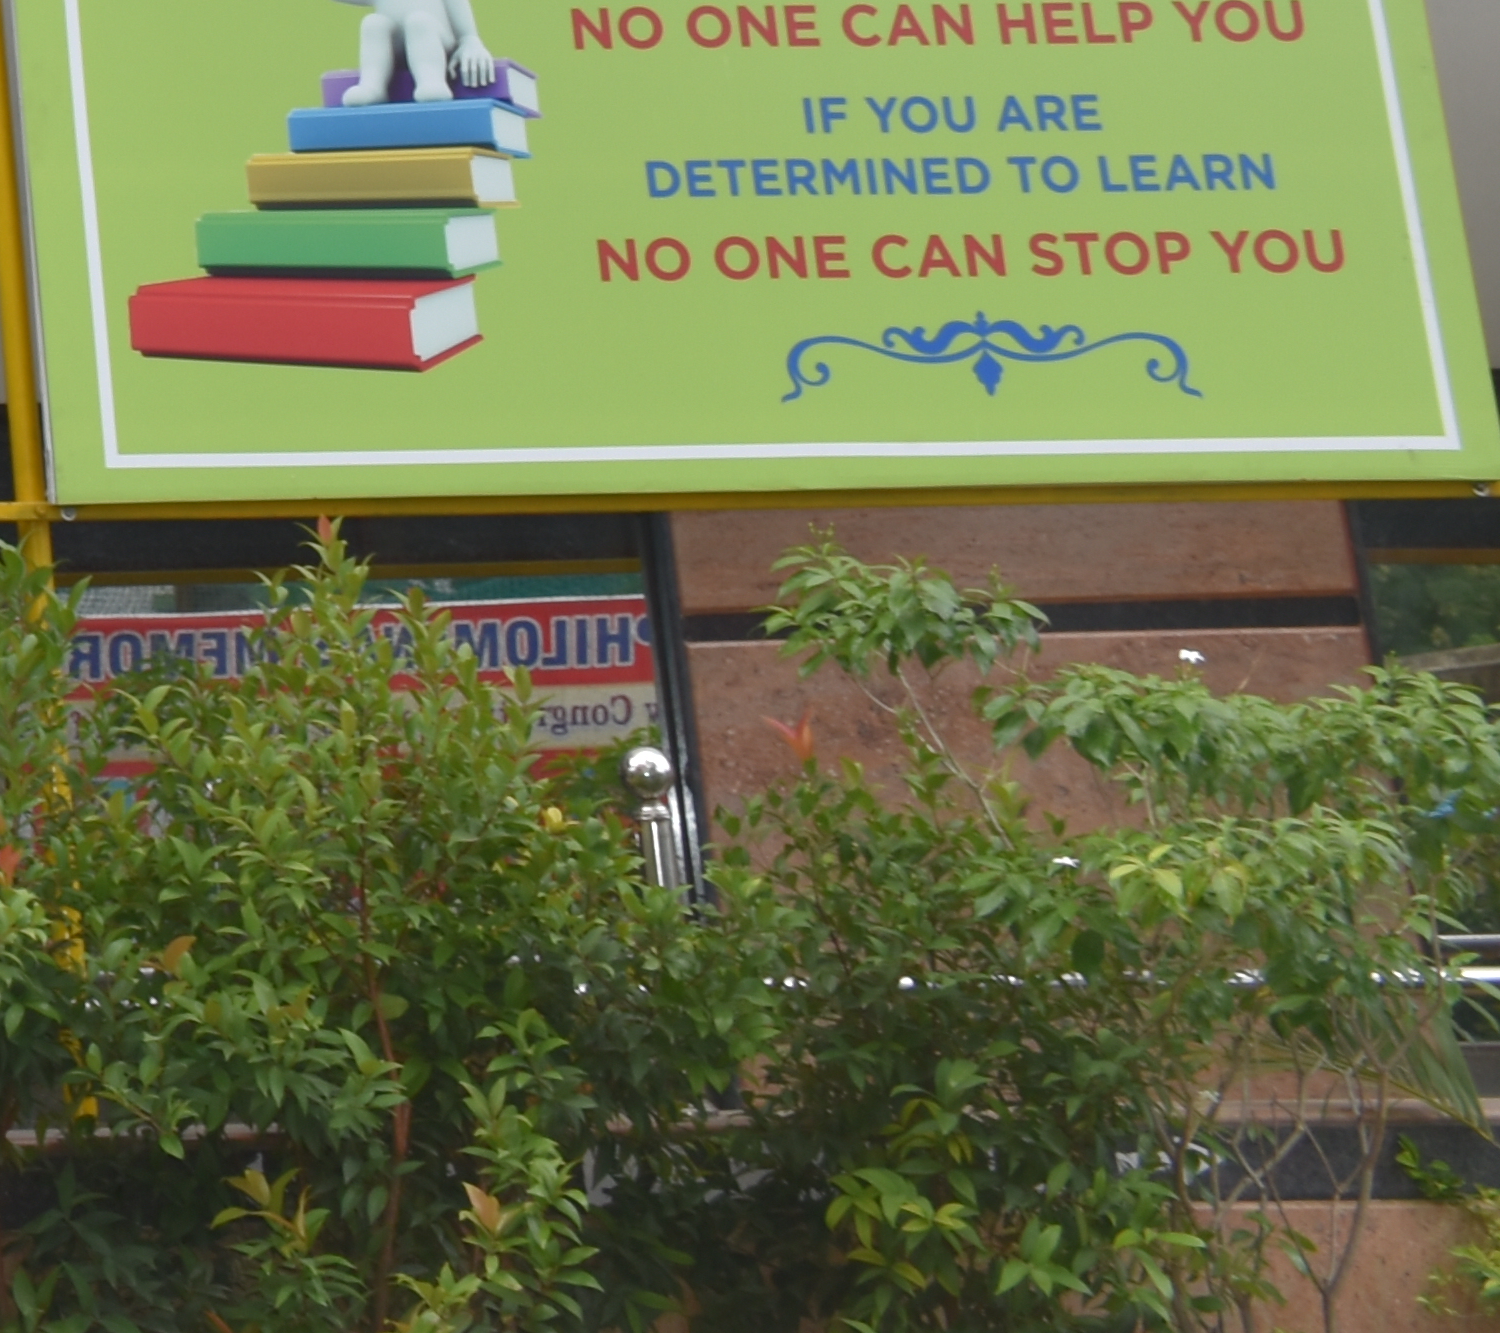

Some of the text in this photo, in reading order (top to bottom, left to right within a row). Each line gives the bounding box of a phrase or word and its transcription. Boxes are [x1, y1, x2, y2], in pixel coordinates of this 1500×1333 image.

[569, 5, 664, 51] NO
[684, 3, 822, 50] ONE
[839, 2, 976, 48] CAN
[995, 0, 1155, 45] HELP
[802, 93, 1103, 134] IF YOU ARE
[644, 151, 1278, 199] DETERMINED TO LEARN
[595, 227, 1347, 283] NO ONE CAN STOP YOU
